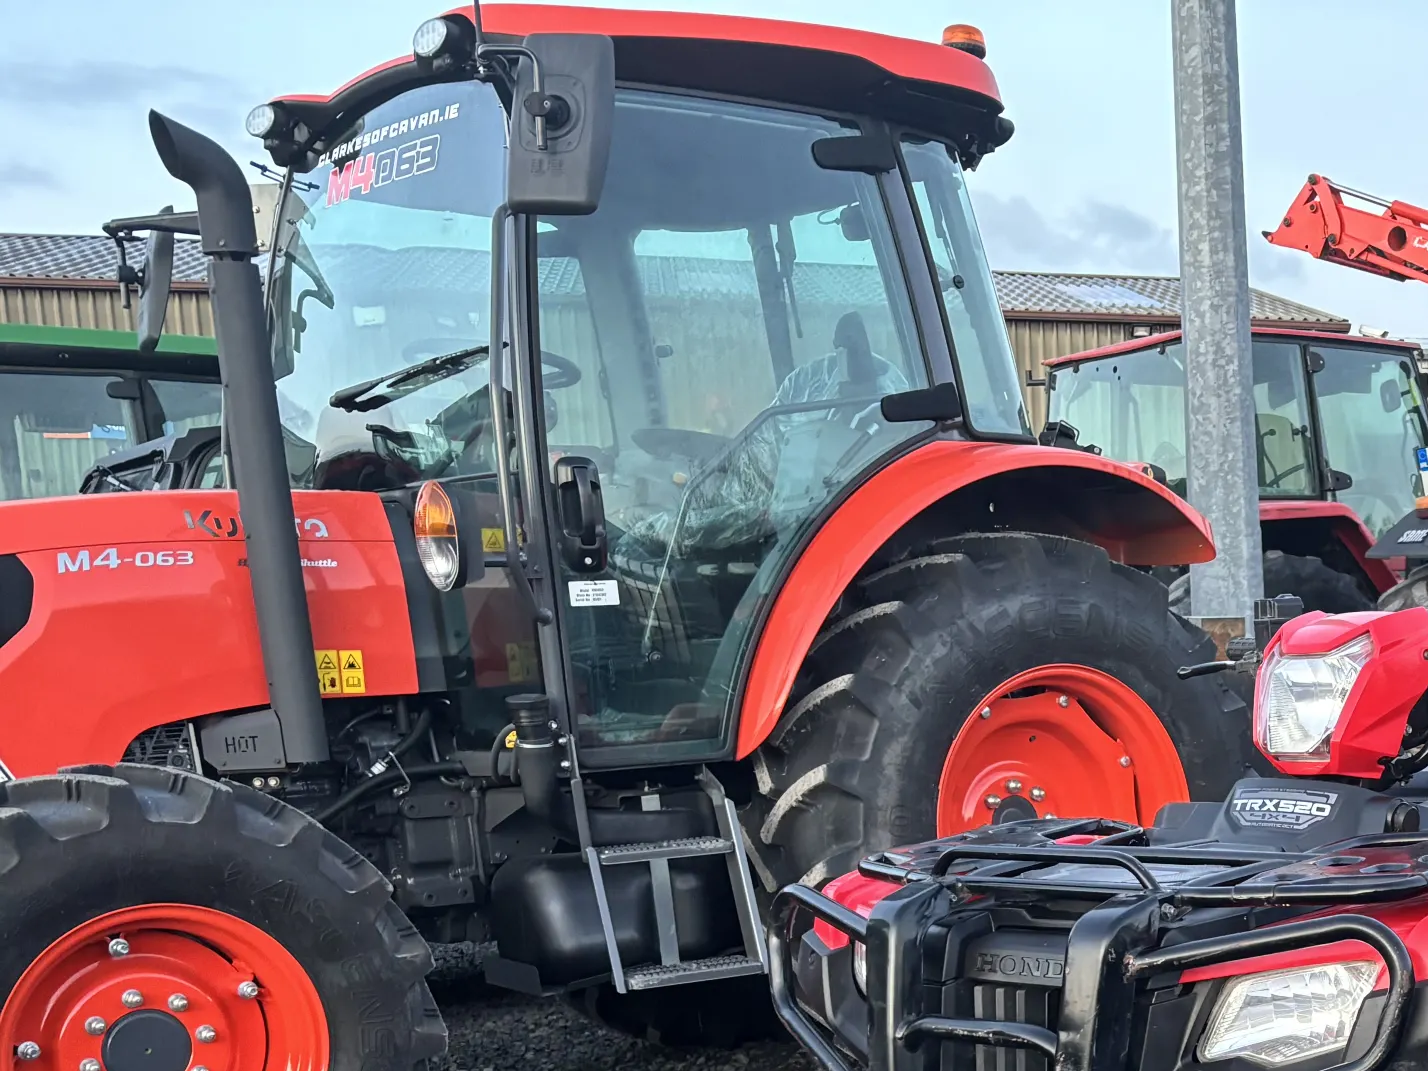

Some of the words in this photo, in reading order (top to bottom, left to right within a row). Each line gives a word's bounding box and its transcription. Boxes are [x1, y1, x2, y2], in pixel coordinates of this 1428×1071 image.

[318, 103, 460, 167] CLARKESOFCAVAN.IE
[326, 134, 441, 208] M4063
[57, 548, 194, 573] M4-063
[225, 735, 258, 753] HOT
[1233, 799, 1331, 817] TRX520
[975, 952, 1065, 979] HOND
